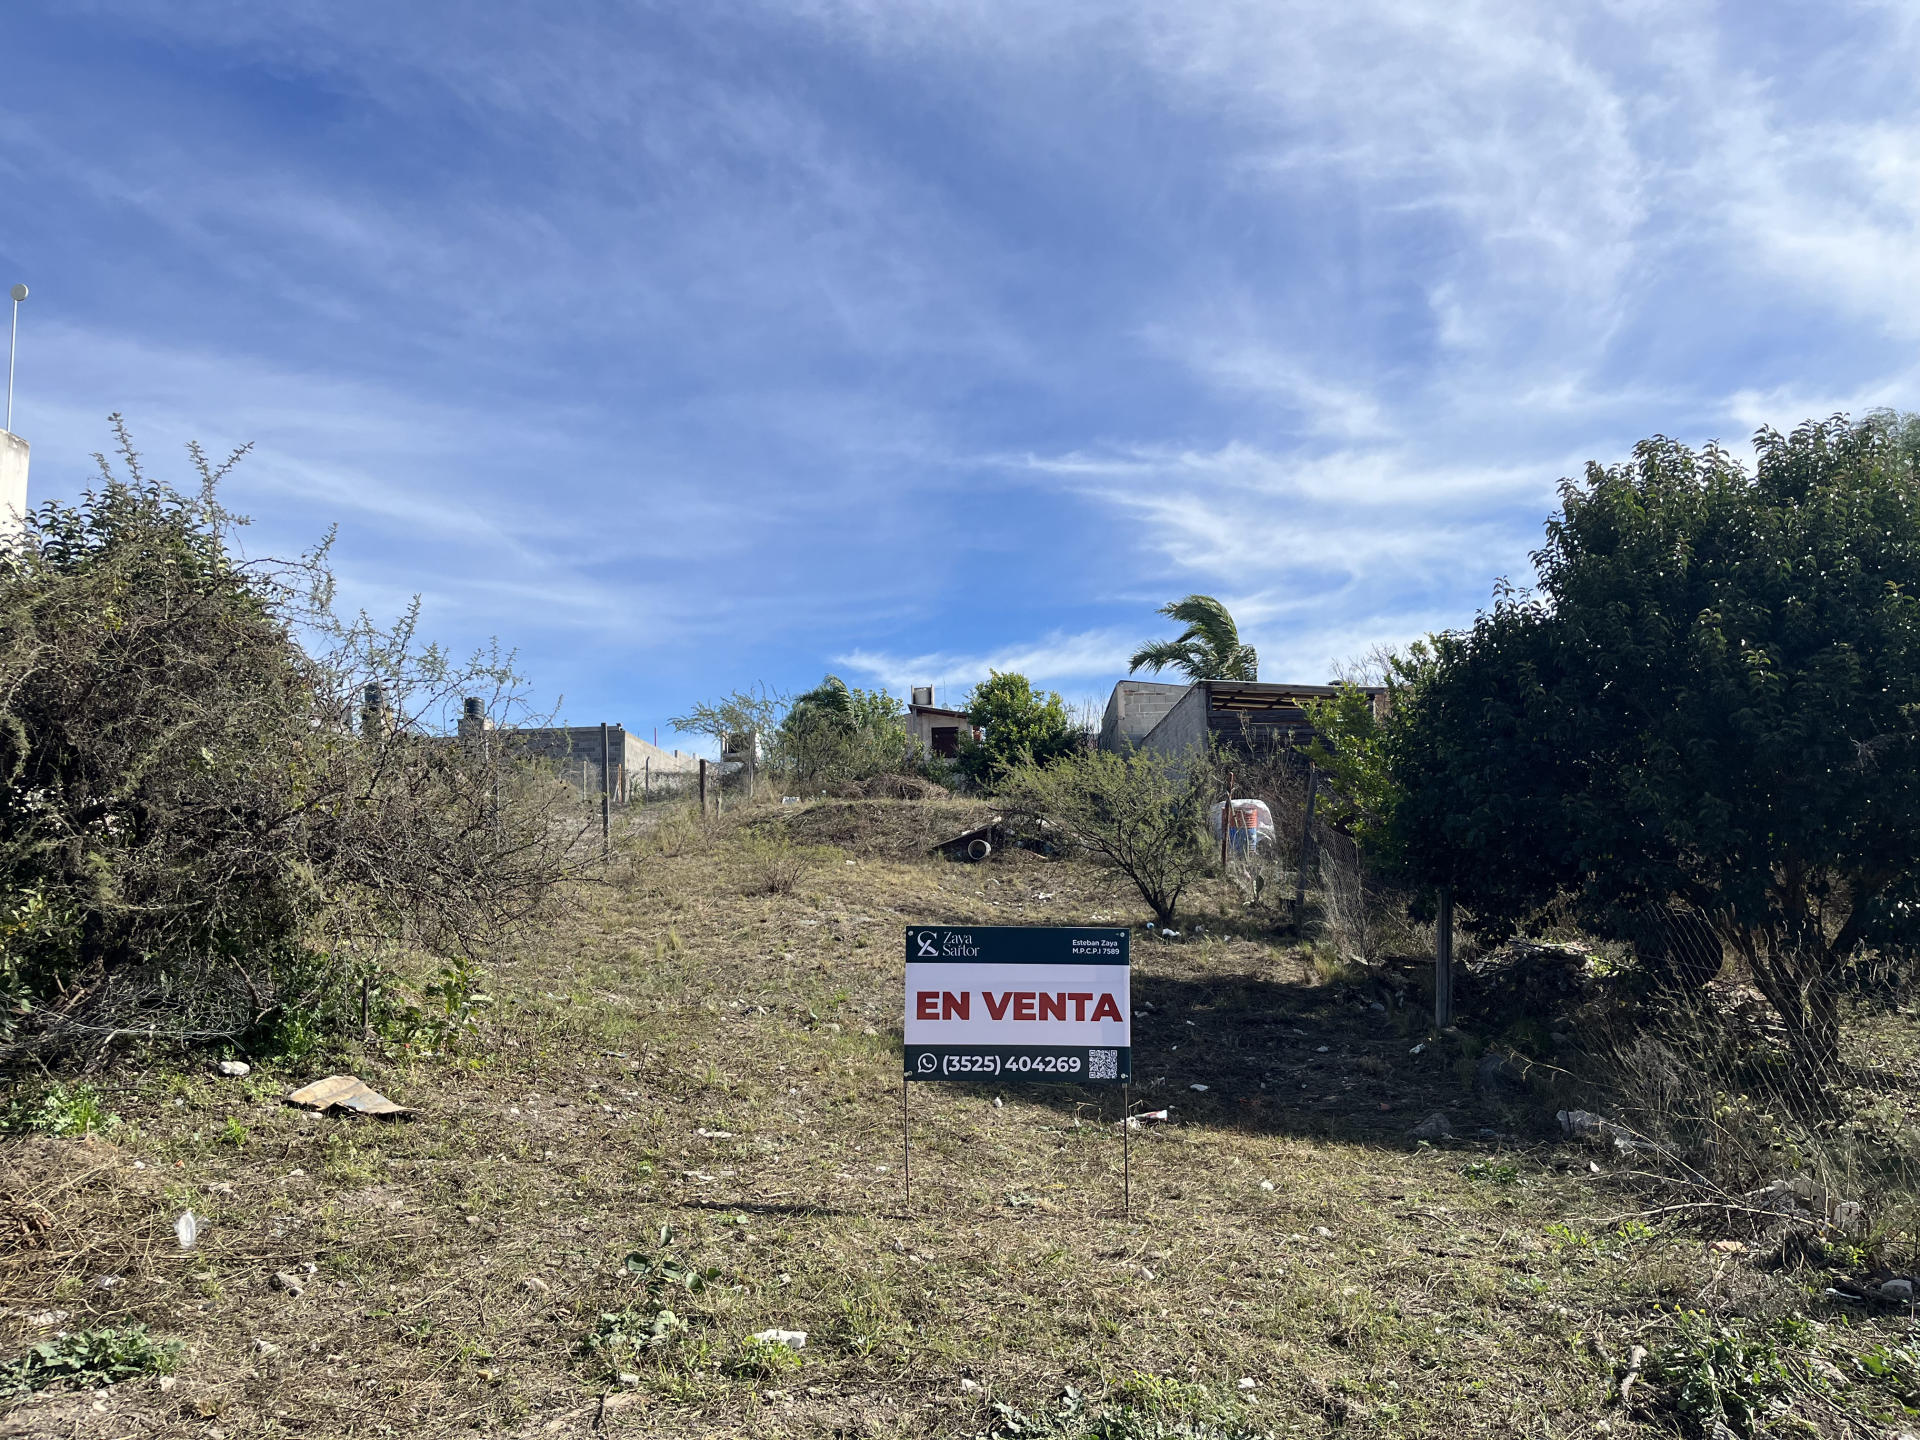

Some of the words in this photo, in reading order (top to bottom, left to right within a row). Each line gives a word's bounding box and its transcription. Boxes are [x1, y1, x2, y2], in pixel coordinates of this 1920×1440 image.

[943, 931, 972, 946] Zaya
[1101, 940, 1118, 948] Zaya
[916, 991, 970, 1020] EN
[982, 992, 1123, 1022] VENTA
[942, 1055, 1001, 1075] (3525)
[1005, 1056, 1081, 1073] 404269
